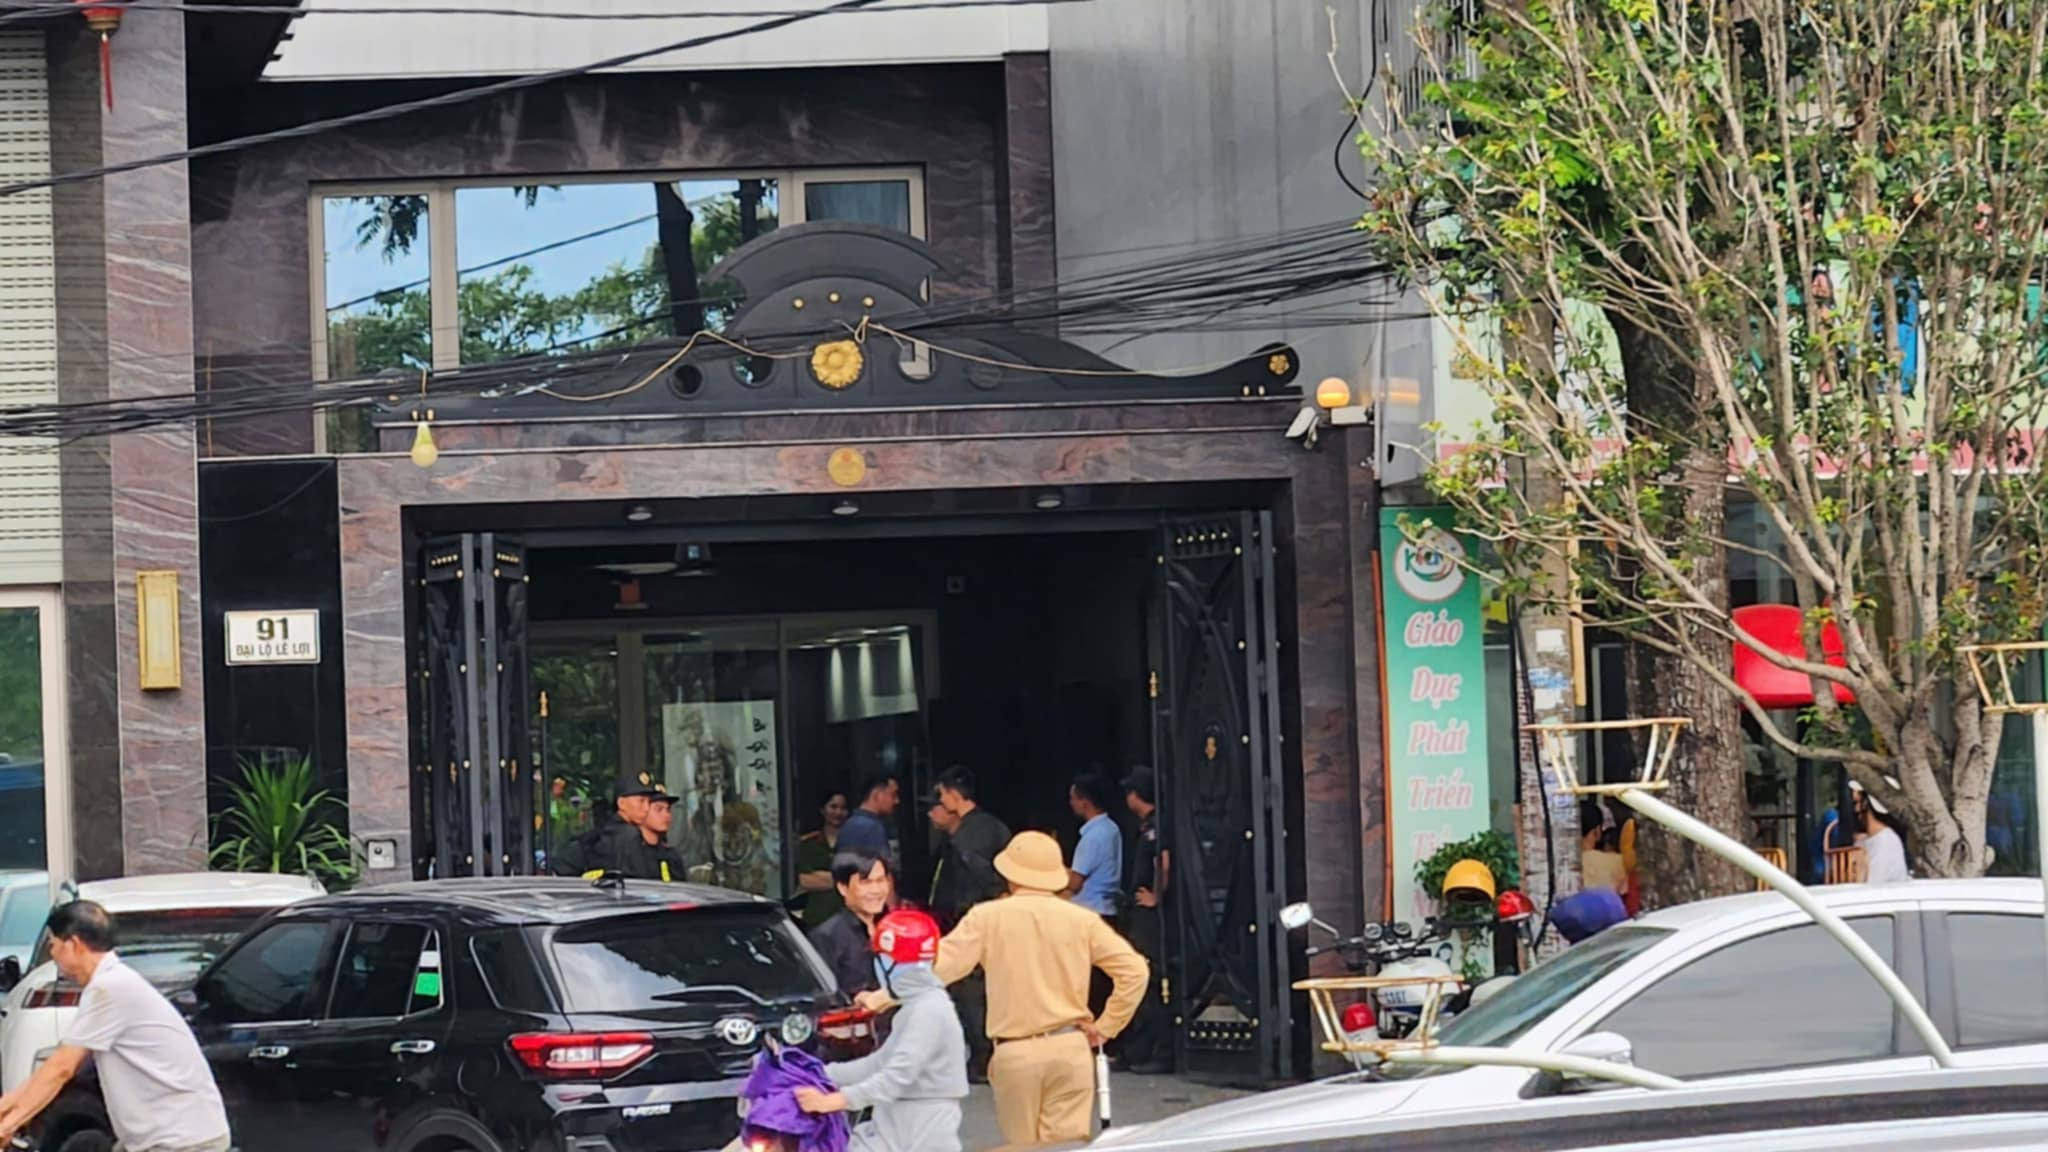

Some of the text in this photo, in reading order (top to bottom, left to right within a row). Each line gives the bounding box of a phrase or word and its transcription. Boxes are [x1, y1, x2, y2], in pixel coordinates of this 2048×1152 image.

[257, 617, 289, 641] 91
[1405, 610, 1462, 647] Giáo
[258, 643, 272, 659] LỘ
[1411, 667, 1462, 709] Dục
[1408, 719, 1468, 756] Phát
[1408, 768, 1473, 809] Triển
